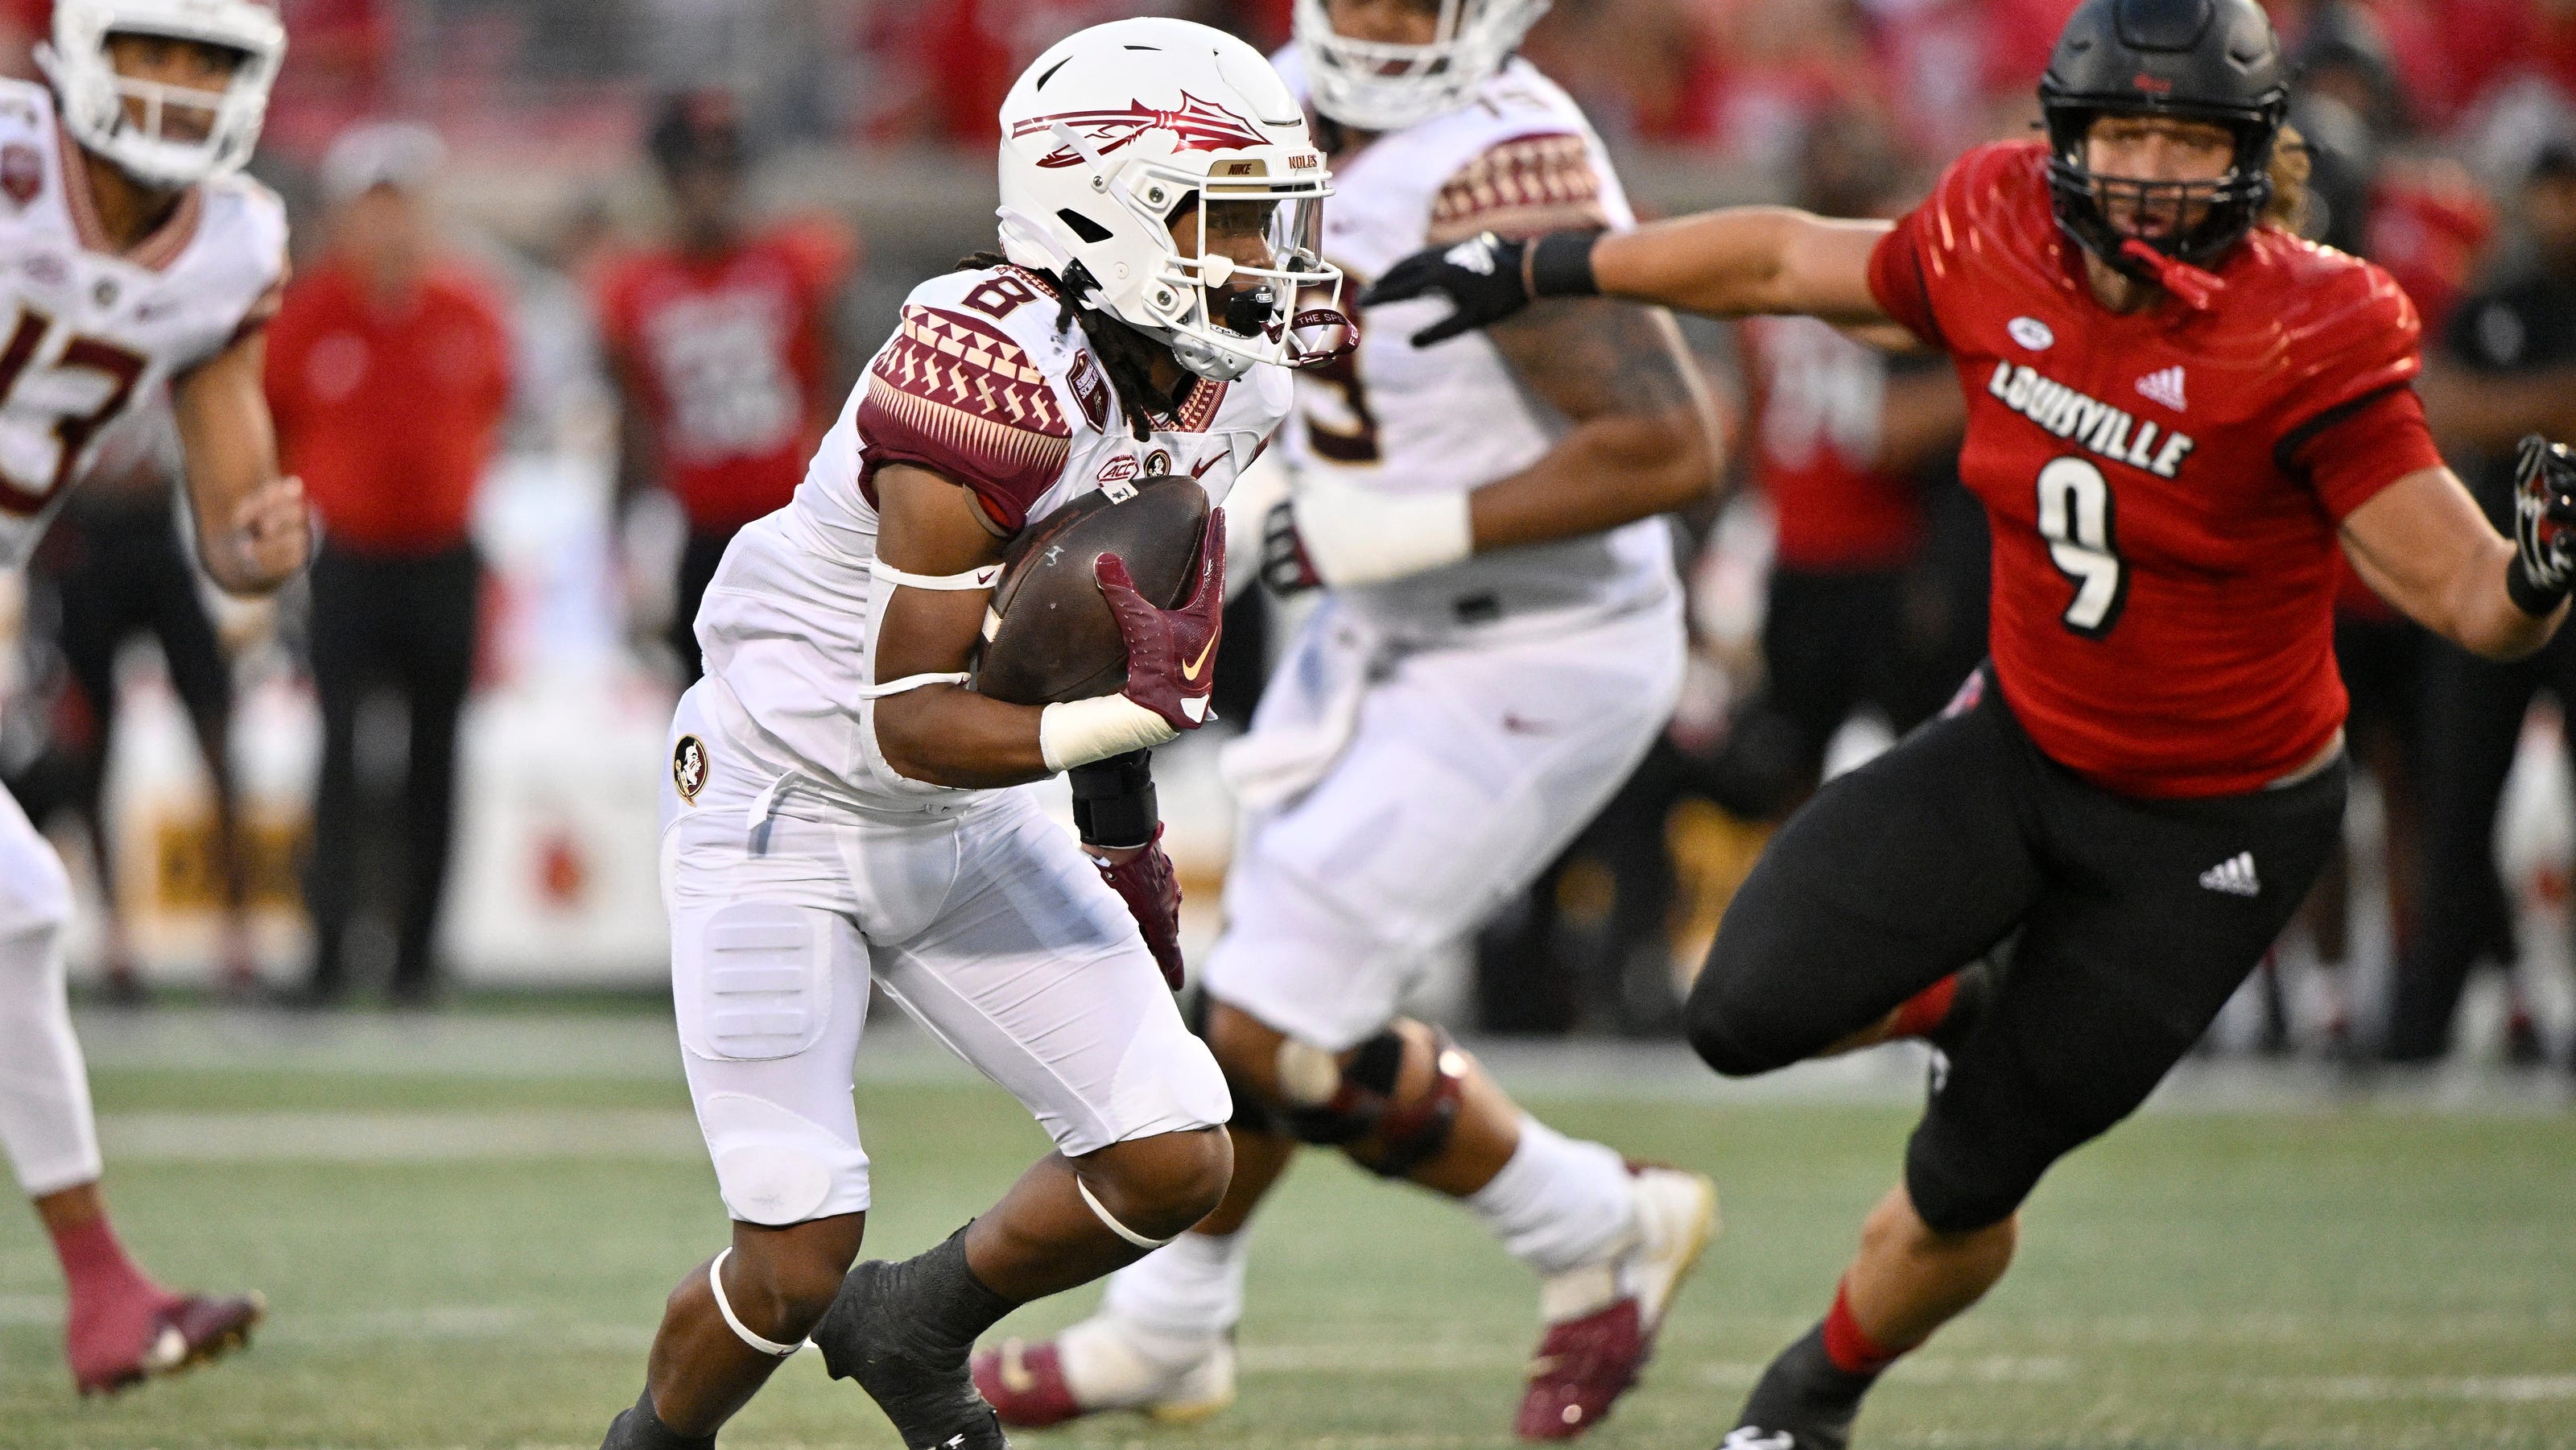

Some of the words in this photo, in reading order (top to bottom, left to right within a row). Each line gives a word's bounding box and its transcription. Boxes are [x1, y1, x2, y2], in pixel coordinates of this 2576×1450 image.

[1228, 163, 1252, 176] NIKE
[1289, 154, 1317, 169] NOLES
[958, 275, 1040, 322] 8
[1298, 313, 1321, 325] THE
[1988, 358, 2195, 479] LOUISVILLE
[1103, 461, 1136, 478] ACC
[2035, 453, 2126, 636] 9
